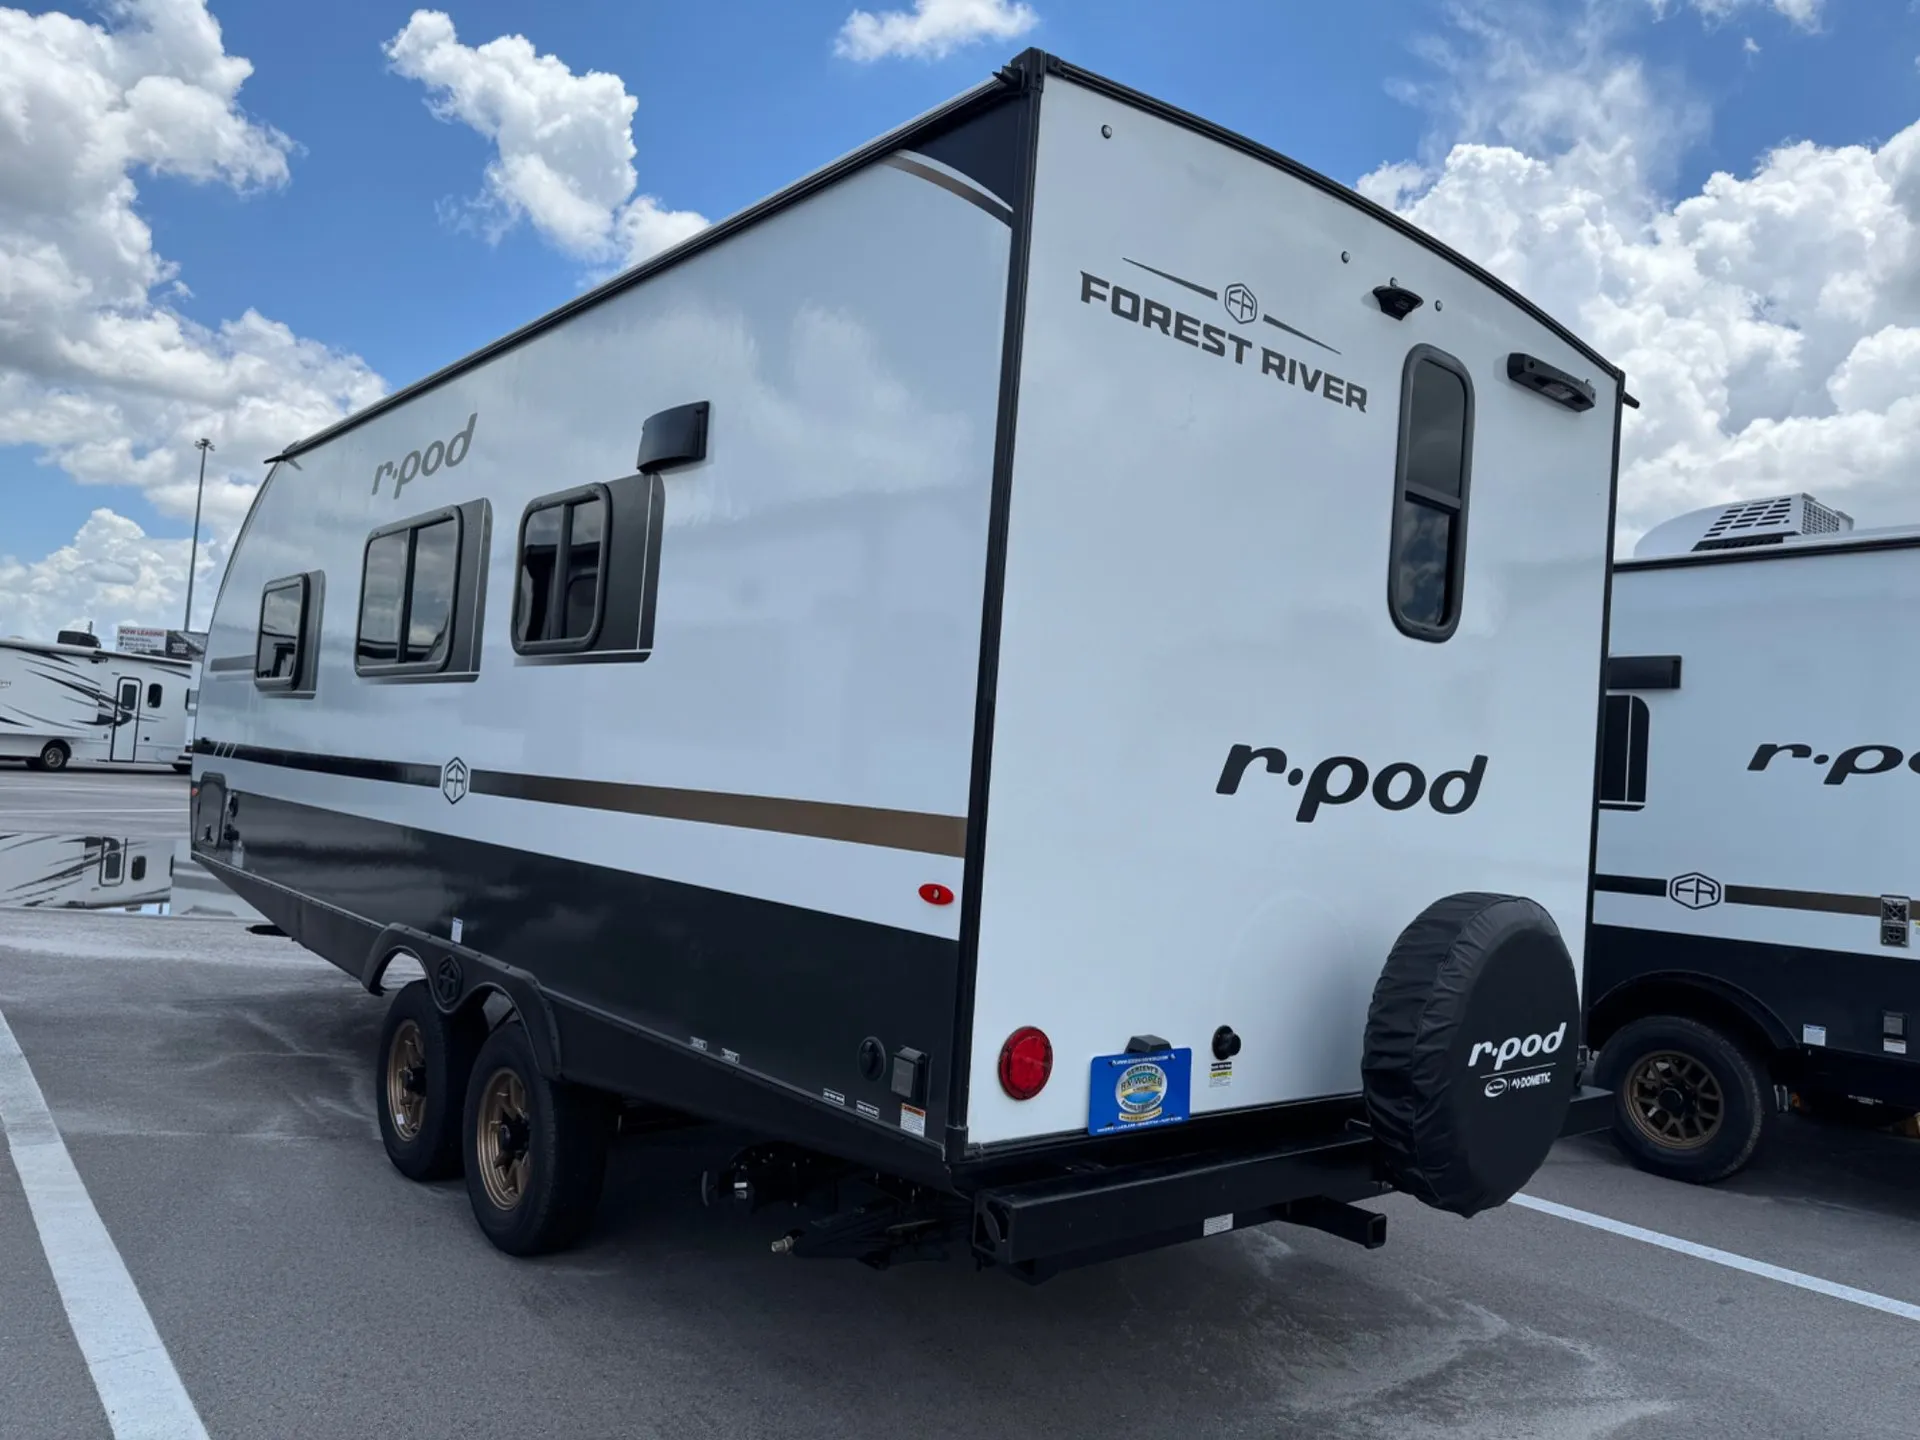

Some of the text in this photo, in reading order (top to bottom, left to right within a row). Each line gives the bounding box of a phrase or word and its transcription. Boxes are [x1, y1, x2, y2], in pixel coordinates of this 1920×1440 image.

[1079, 270, 1367, 413] FOREST RIVER
[1135, 1076, 1163, 1087] WORLD
[1520, 1072, 1551, 1088] DOMETIC
